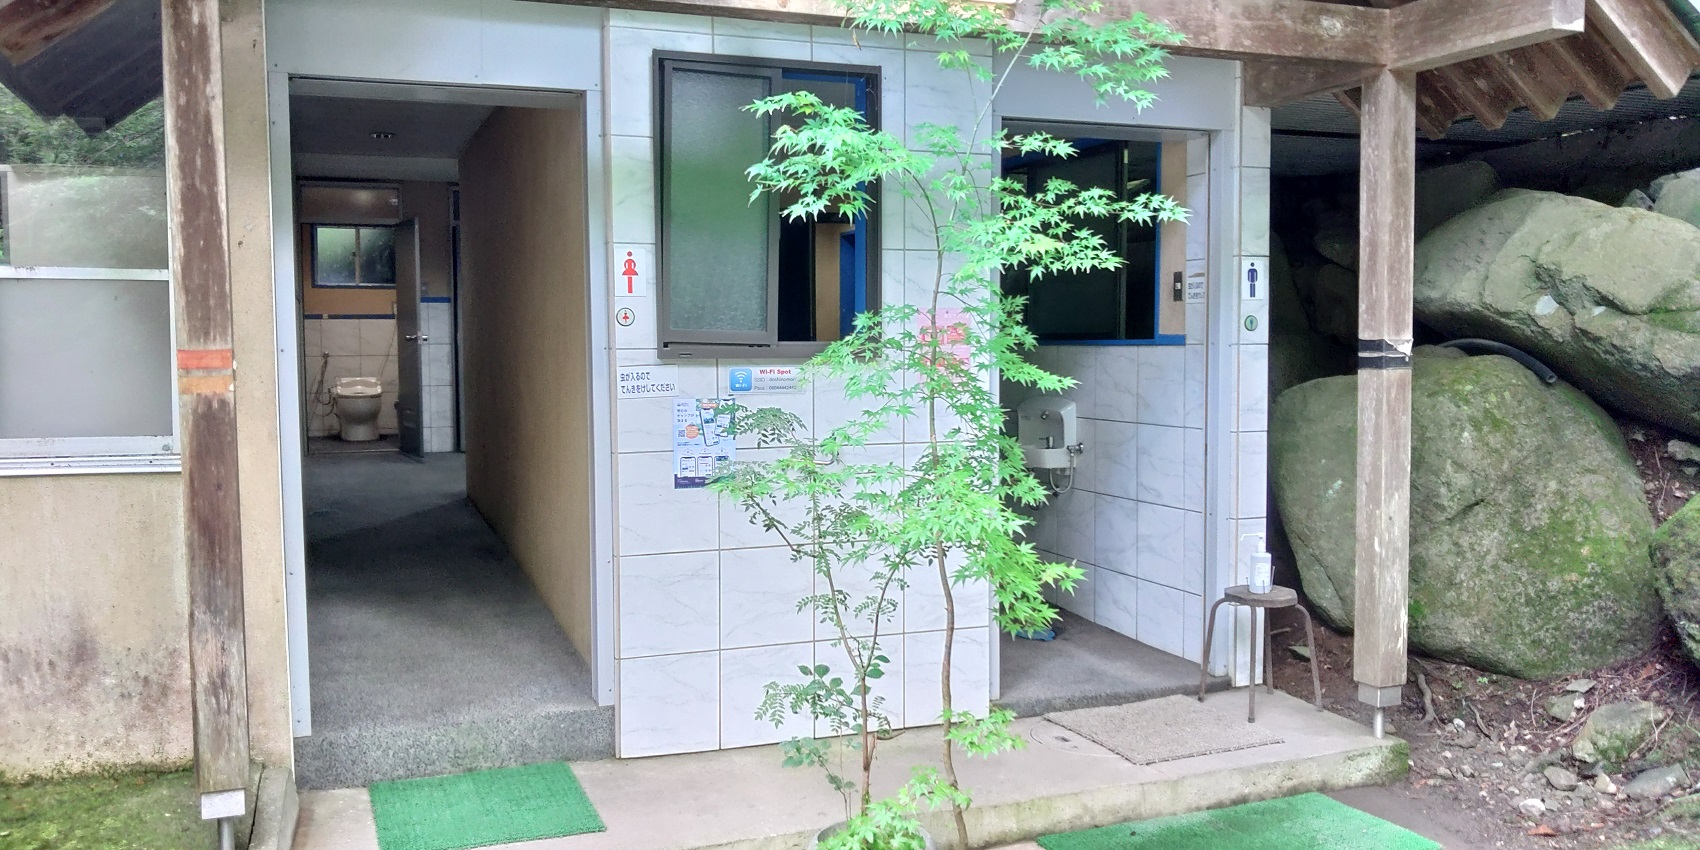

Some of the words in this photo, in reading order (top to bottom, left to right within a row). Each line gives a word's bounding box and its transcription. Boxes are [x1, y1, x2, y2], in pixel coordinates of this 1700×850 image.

[620, 371, 651, 382] 虫が入るので
[620, 383, 676, 394] てんきをけしてください
